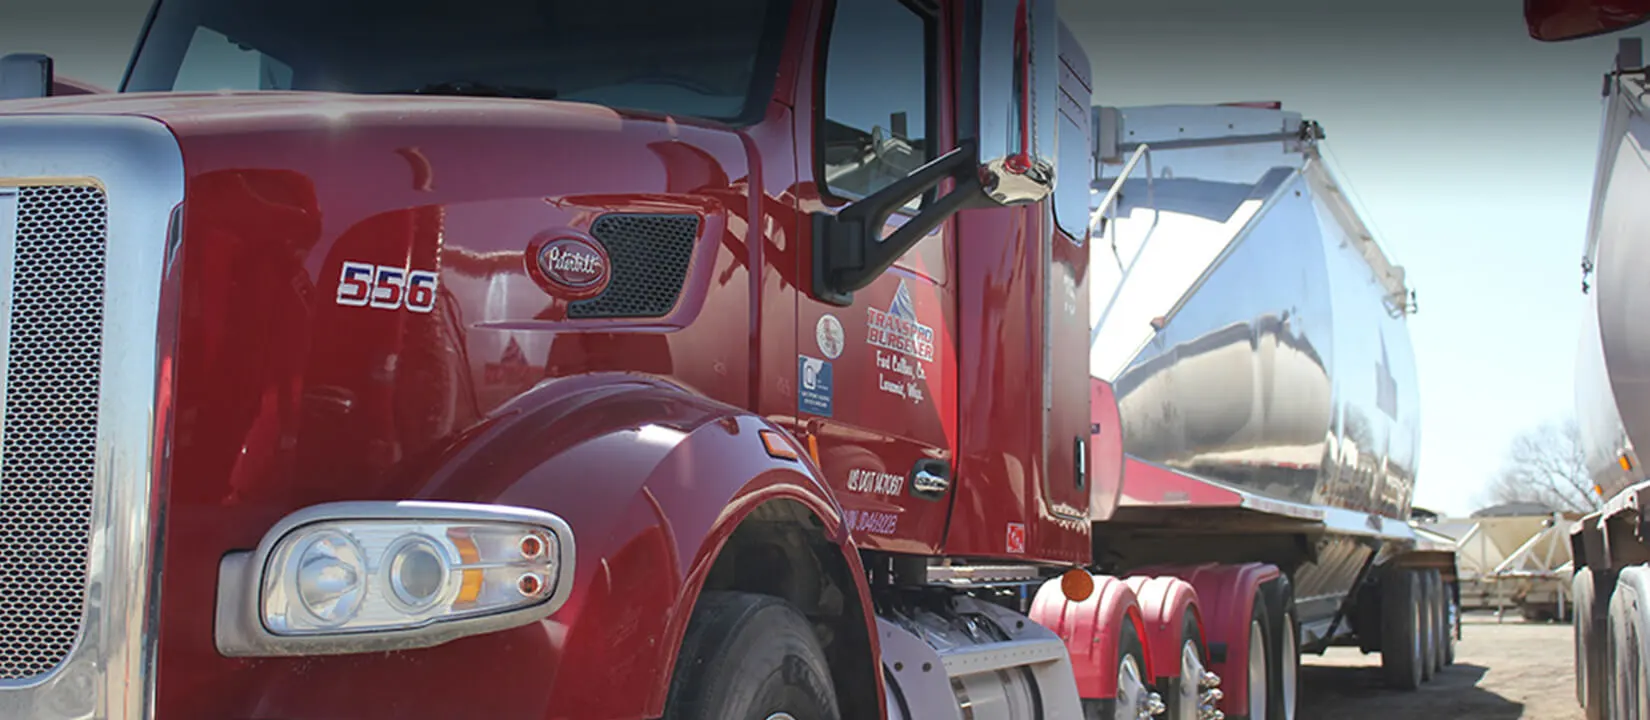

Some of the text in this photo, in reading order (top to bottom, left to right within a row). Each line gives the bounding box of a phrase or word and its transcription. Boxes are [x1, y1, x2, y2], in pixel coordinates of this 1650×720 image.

[547, 246, 601, 275] Peterbilt
[337, 261, 438, 313] 556
[868, 307, 933, 343] TRANSPRO
[868, 326, 933, 361] BURGENER
[859, 469, 876, 493] DOT
